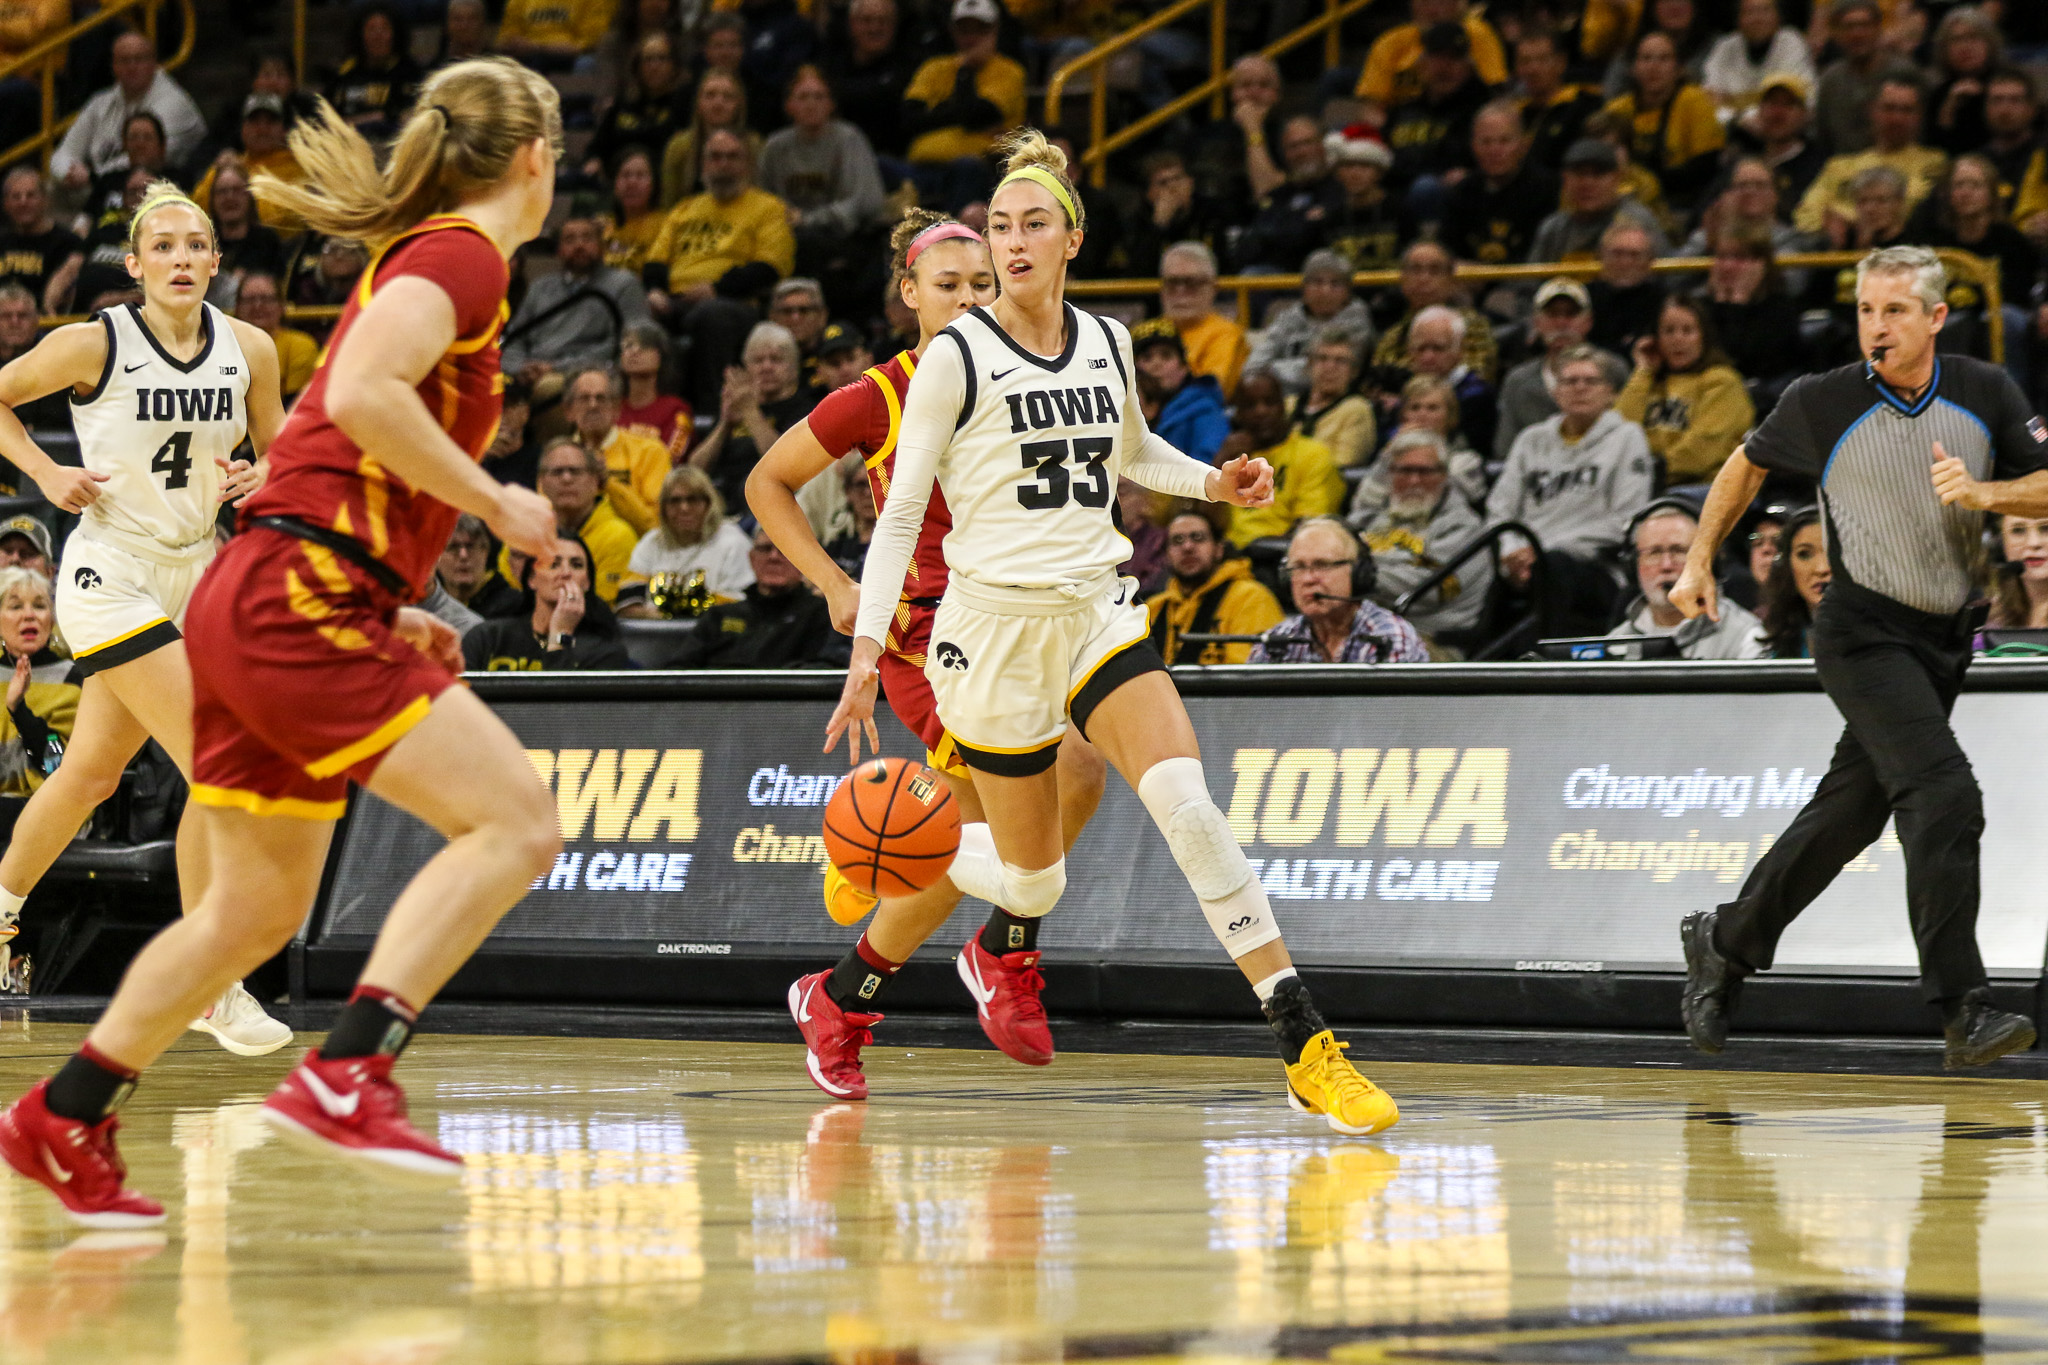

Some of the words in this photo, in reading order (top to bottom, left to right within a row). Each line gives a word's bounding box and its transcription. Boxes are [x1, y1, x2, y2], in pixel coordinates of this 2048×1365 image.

[136, 387, 233, 422] IOWA
[1005, 386, 1120, 434] IOWA
[151, 431, 193, 490] 4
[1017, 437, 1113, 510] 33
[521, 748, 704, 842] WA
[1226, 747, 1511, 848] IOWA
[1562, 764, 1754, 818] Changing
[585, 851, 695, 892] CARE
[1375, 857, 1501, 902] CARE
[1547, 828, 1750, 884] Changing
[656, 943, 732, 955] DAKTRONICS
[1515, 960, 1604, 972] DAKTRONICS
